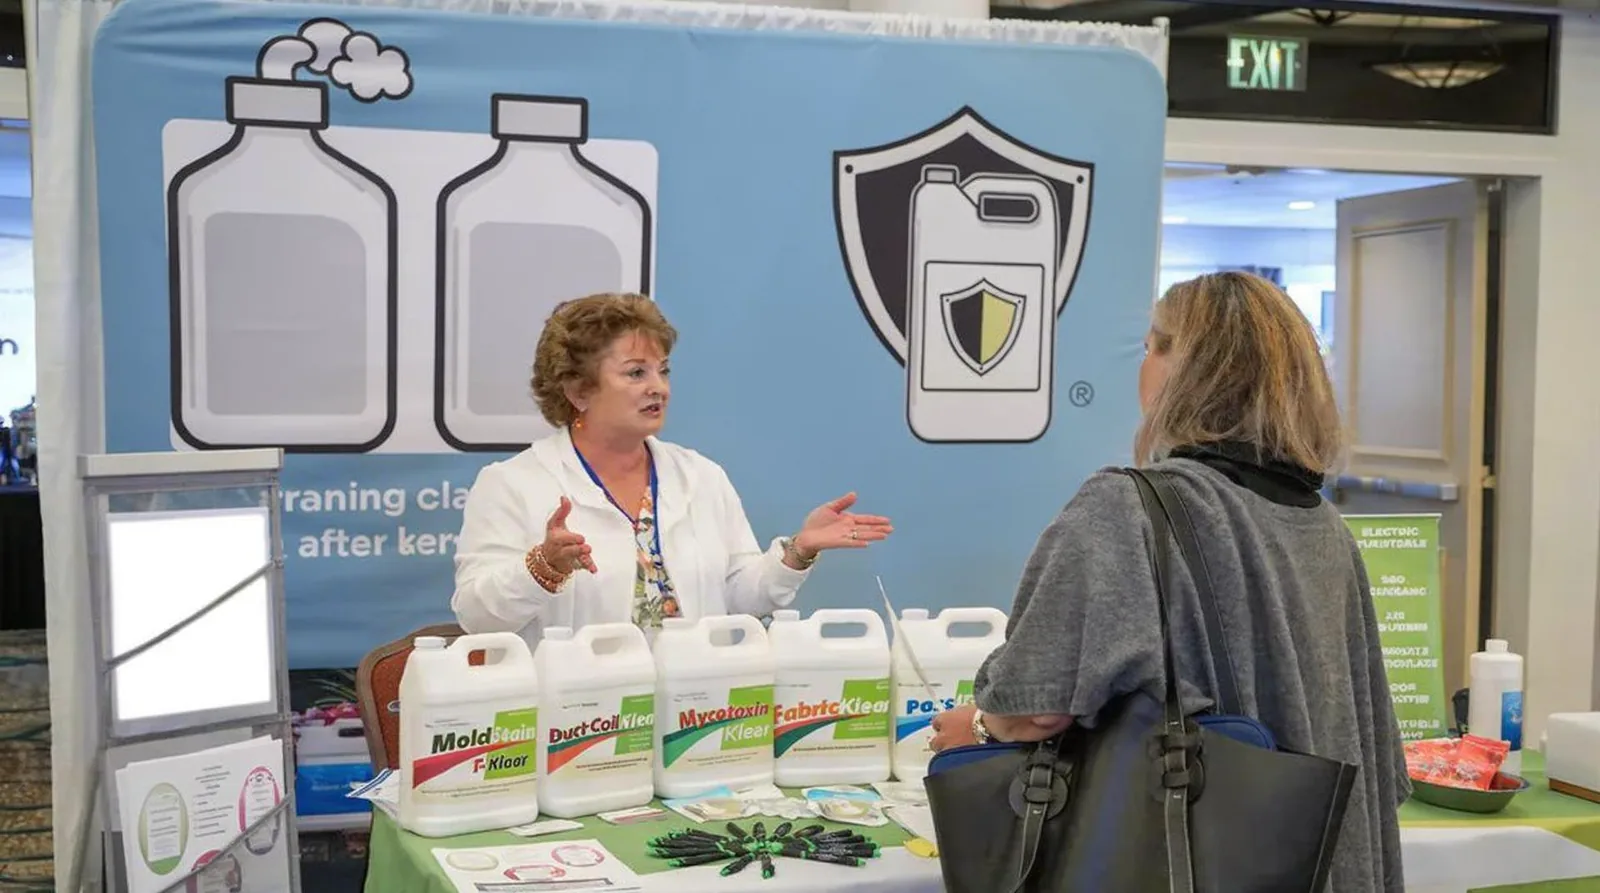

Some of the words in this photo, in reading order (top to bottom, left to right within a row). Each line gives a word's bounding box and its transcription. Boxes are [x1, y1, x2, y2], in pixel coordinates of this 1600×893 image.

[1227, 38, 1300, 89] EXIT
[279, 481, 407, 517] raning
[298, 528, 388, 558] after
[679, 701, 769, 730] Mycotoxin
